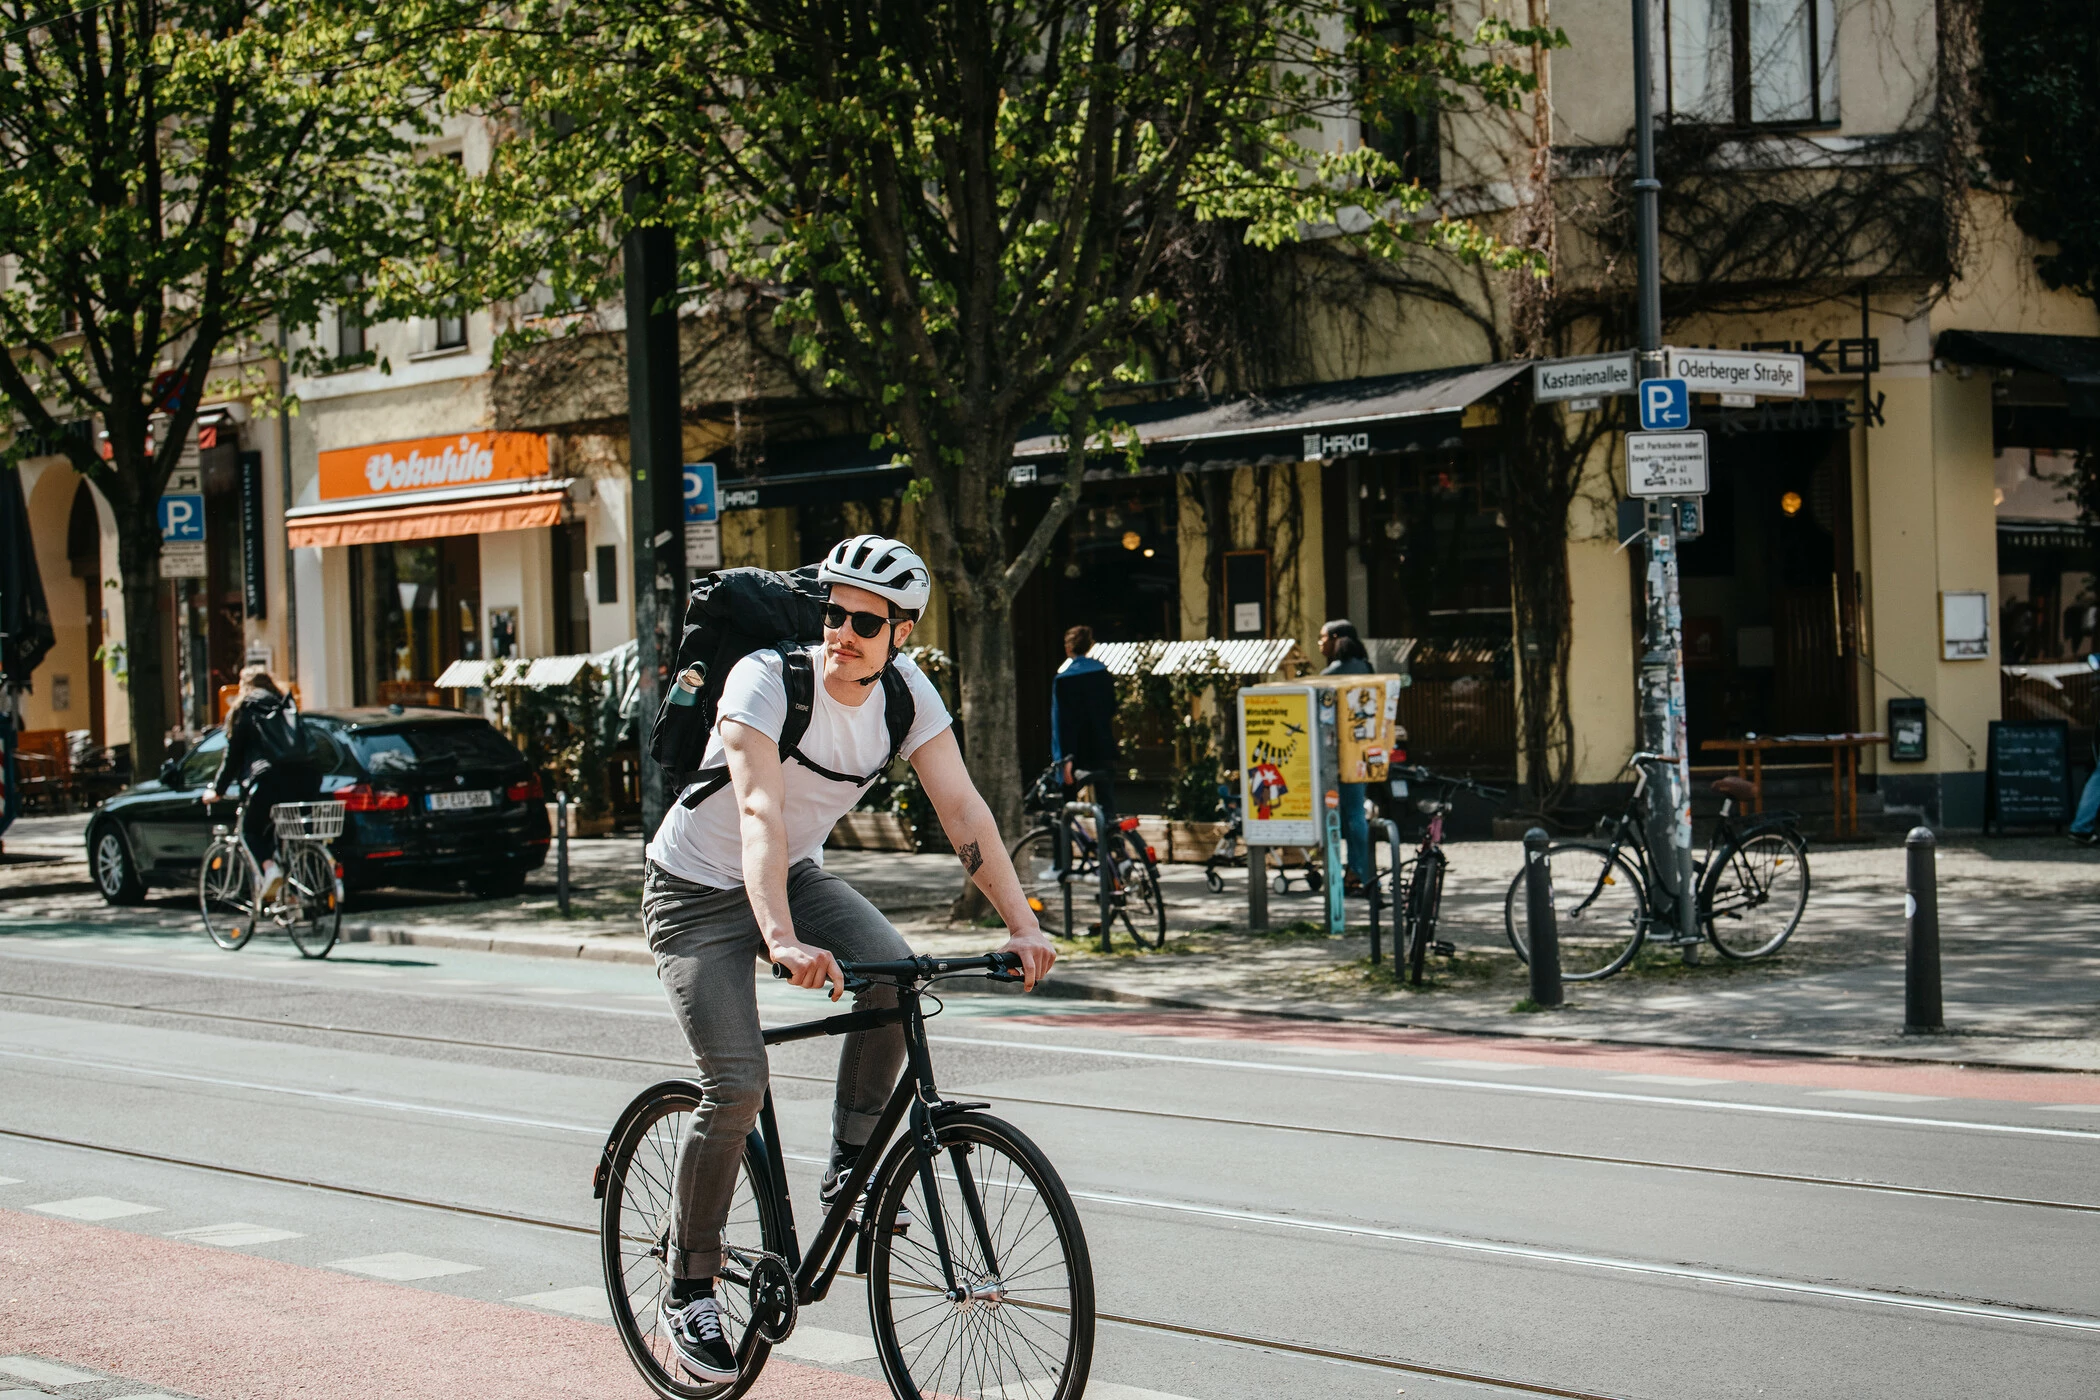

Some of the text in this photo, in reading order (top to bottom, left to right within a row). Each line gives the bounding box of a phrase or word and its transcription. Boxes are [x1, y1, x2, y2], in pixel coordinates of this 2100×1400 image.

[1708, 338, 1879, 374] KO
[1541, 364, 1629, 390] Kastanienallee
[1677, 358, 1794, 387] Oderberger Straße
[1647, 385, 1673, 424] P
[1321, 432, 1369, 453] HAKO
[1647, 441, 1682, 450] Parkschein
[1685, 441, 1699, 449] oder
[166, 500, 193, 536] P
